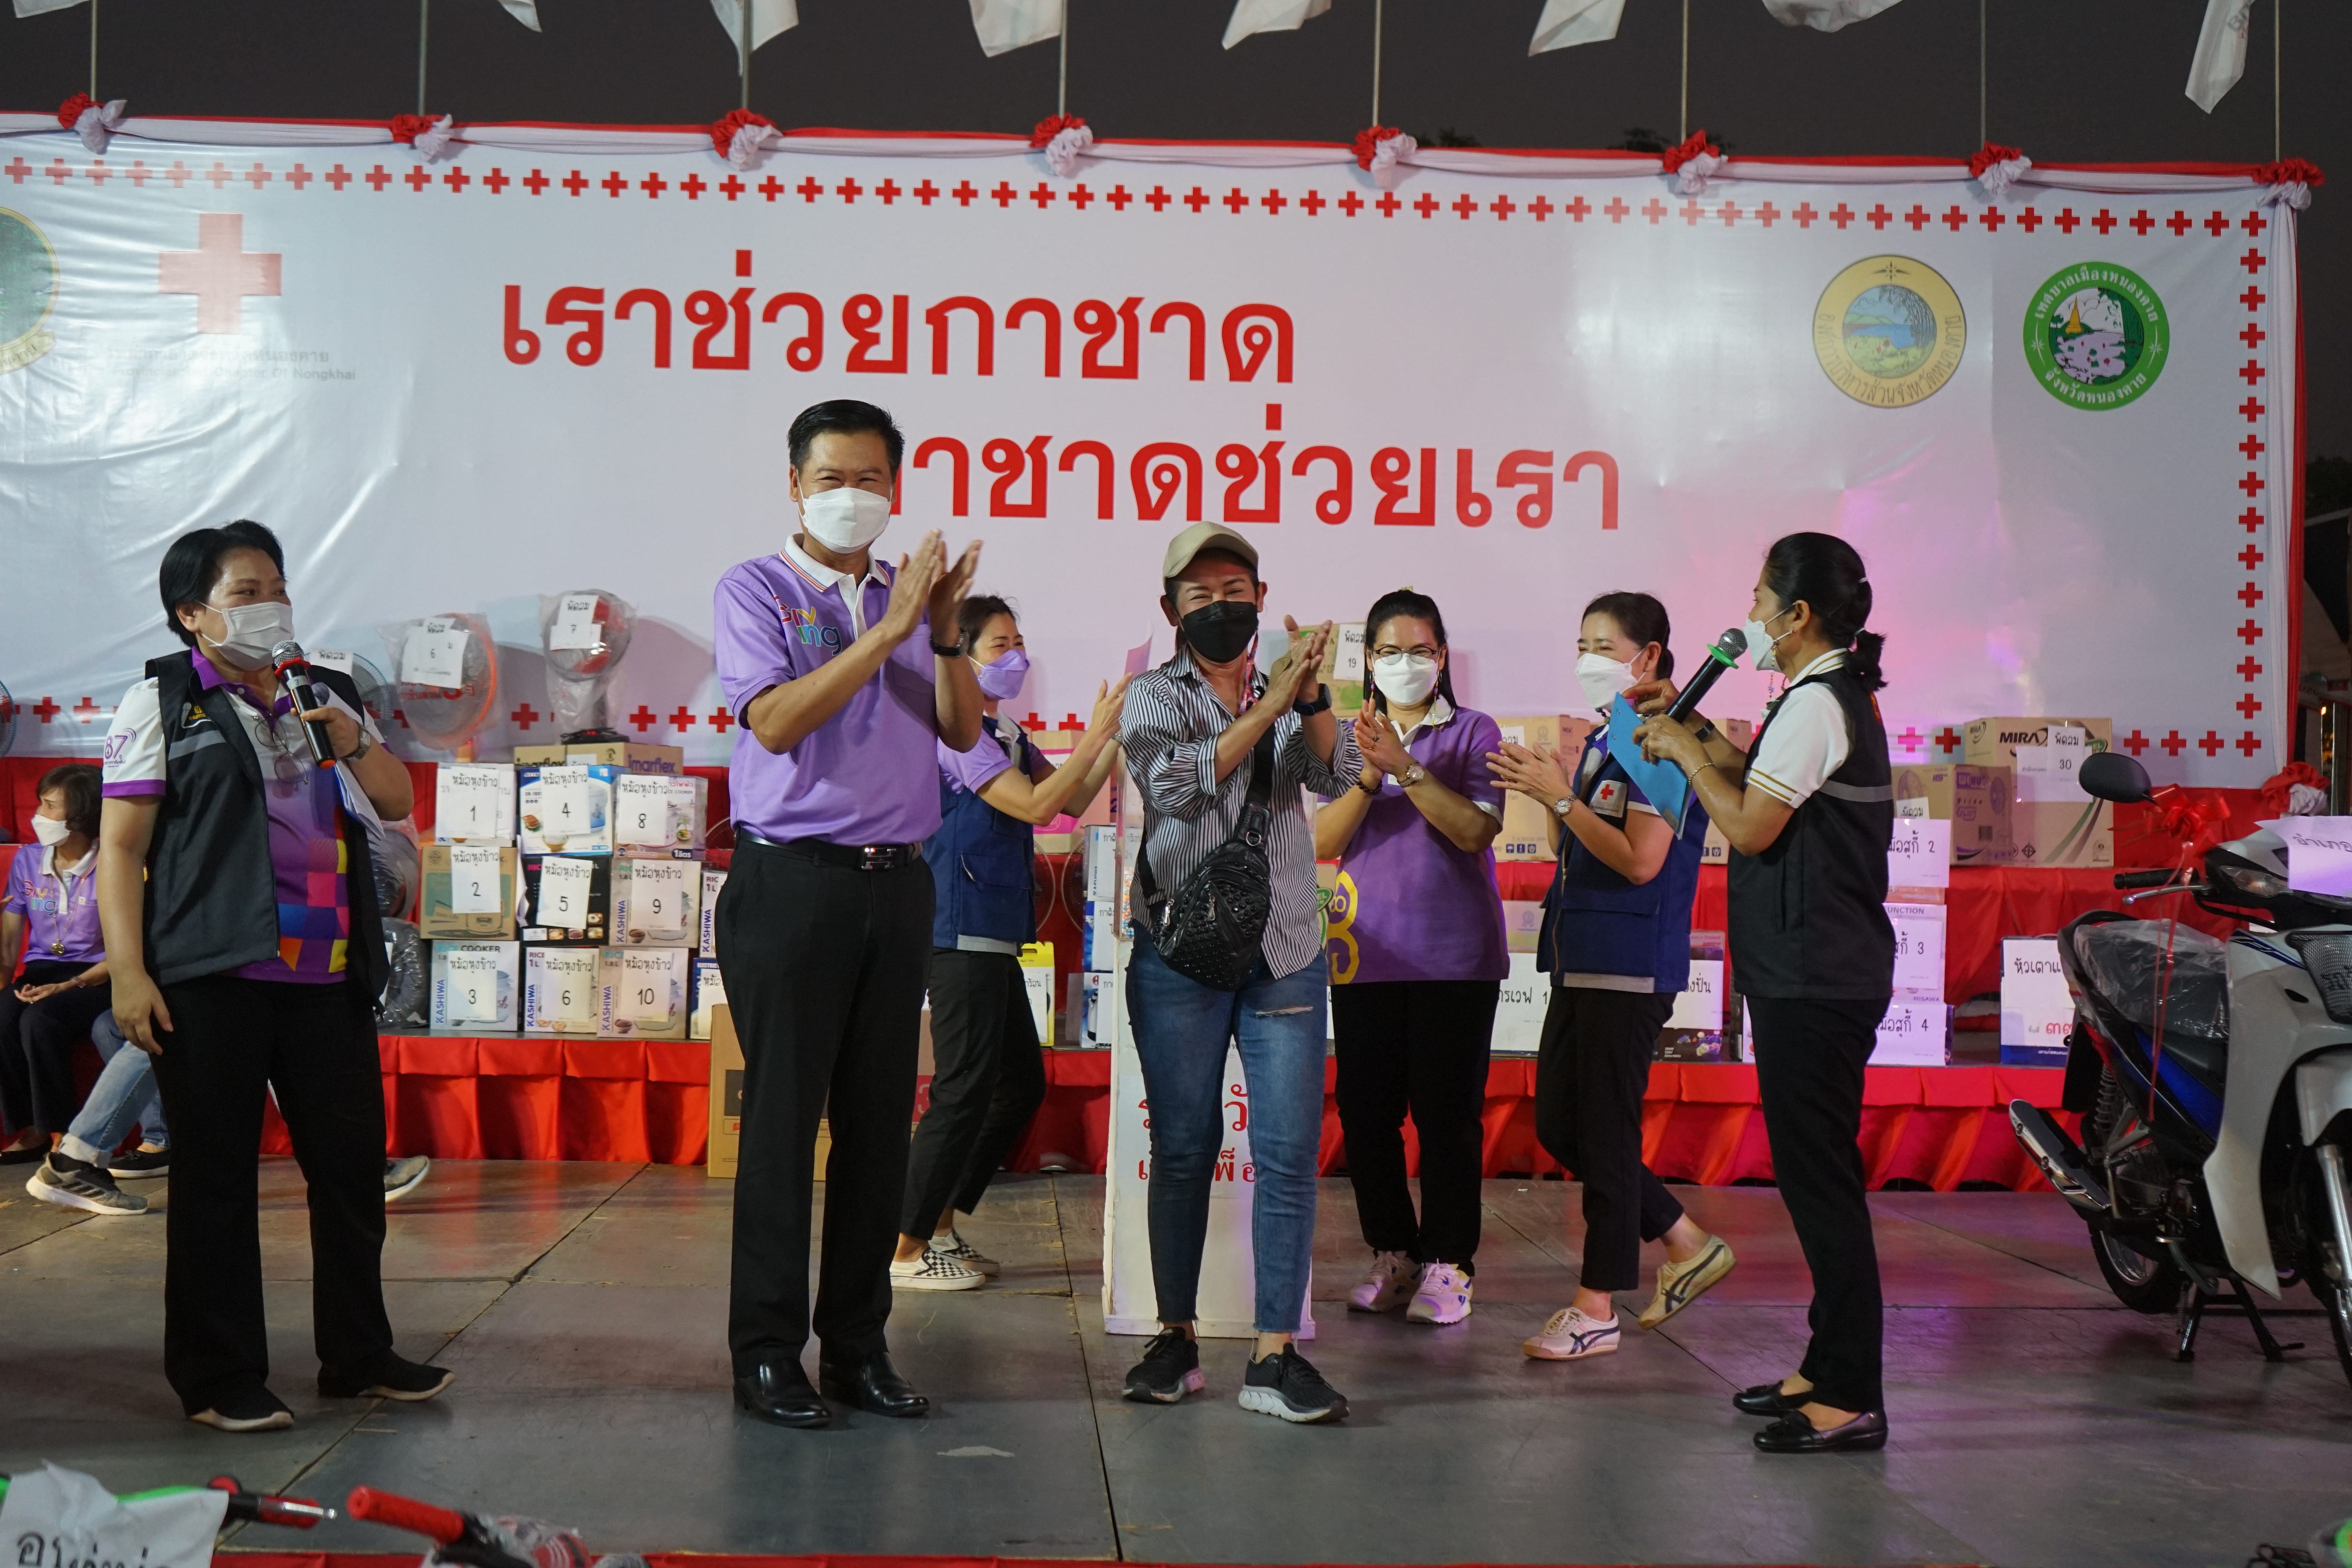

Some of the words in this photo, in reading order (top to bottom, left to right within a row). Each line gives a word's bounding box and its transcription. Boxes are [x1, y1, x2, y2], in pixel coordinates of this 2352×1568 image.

[502, 250, 1295, 383] เราช่วยกาชาด
[294, 368, 356, 381] Nongkhai
[890, 404, 1621, 530] าชาดช่วยเรา
[571, 624, 577, 634] 7
[430, 648, 435, 659] 6
[1348, 657, 1356, 668] 19
[2000, 732, 2040, 744] MIRA
[105, 735, 128, 759] 87
[628, 753, 676, 774] imarflex
[2060, 759, 2072, 770] 30
[452, 773, 498, 790] หม้อหุงข้าว
[543, 771, 588, 789] หม้อหุงข้าว
[622, 780, 668, 798] หม้อหุงข้าว
[470, 805, 476, 822] 1
[562, 802, 571, 818] 4
[639, 813, 647, 829] 8
[1887, 830, 1919, 859] ม้อสุกี้
[1928, 840, 1935, 853] 2
[2292, 833, 2352, 853] อำเภอ
[453, 850, 499, 867] หม้อหุงข้าว
[545, 864, 591, 881] หม้อหุงข้าว
[635, 866, 682, 883] หม้อหุงข้าว
[471, 882, 481, 897] 2
[558, 896, 568, 911] 5
[652, 899, 662, 914] 9
[616, 900, 626, 943] KASHIWA
[702, 909, 712, 952] KASHIWA
[1918, 942, 1924, 955] 3
[450, 957, 496, 974] หม้อหุงข้าว
[546, 958, 592, 975] หม้อหุงข้าว
[625, 956, 671, 974] หม้อหุงข้าว
[2014, 957, 2061, 975] หัวเตาแ
[704, 974, 721, 987] หม้อ
[436, 979, 446, 1024] KASHIWA
[468, 989, 476, 1004] 3
[562, 990, 571, 1006] 6
[637, 988, 655, 1005] 10
[1543, 991, 1548, 1005] 1
[526, 984, 535, 1027] KASHIWA
[601, 985, 612, 1031] KASHIWA
[1875, 1009, 1912, 1038] ม้อสุกี้
[1921, 1019, 1929, 1032] 4
